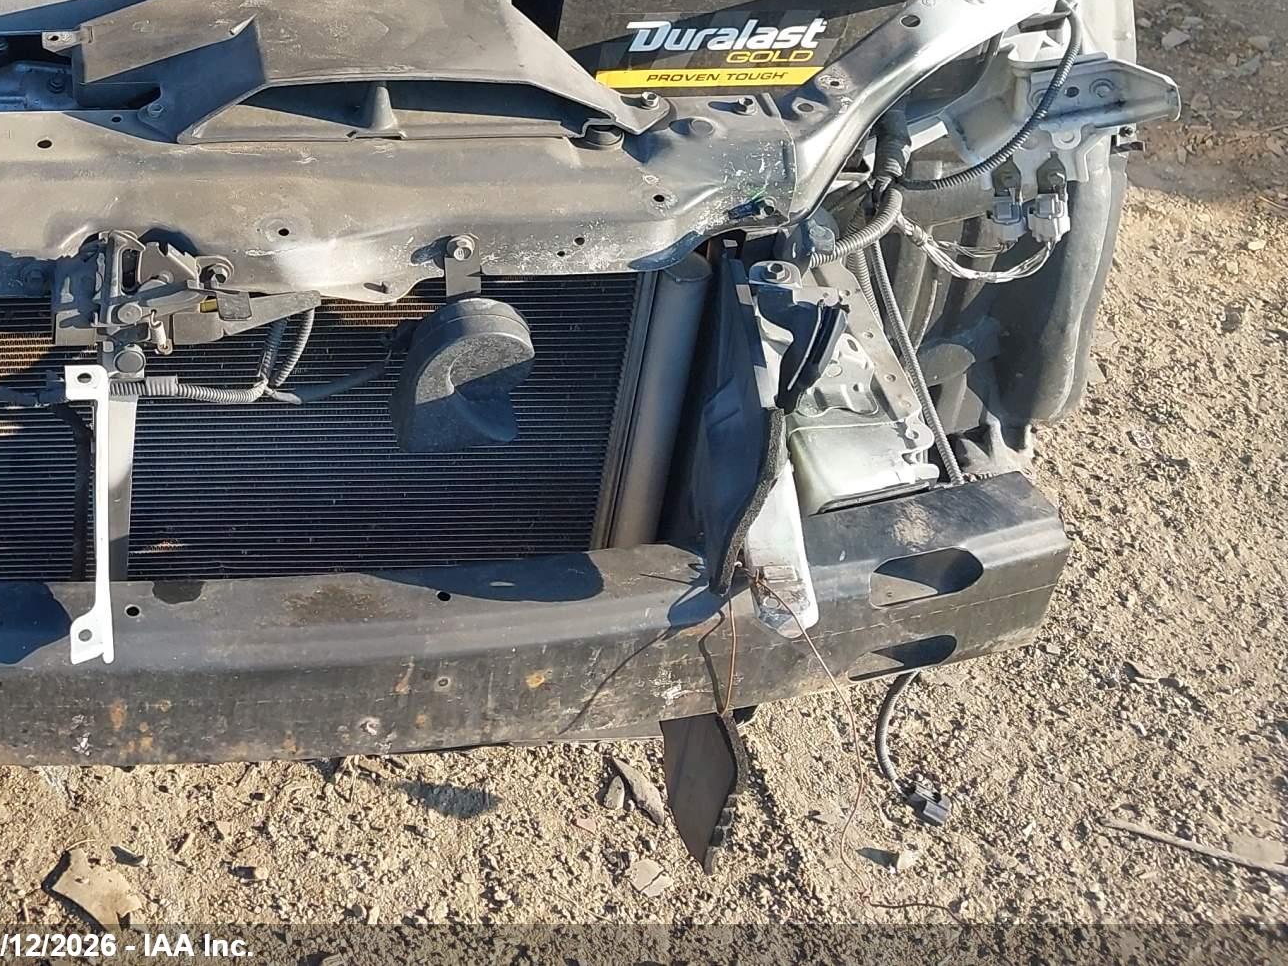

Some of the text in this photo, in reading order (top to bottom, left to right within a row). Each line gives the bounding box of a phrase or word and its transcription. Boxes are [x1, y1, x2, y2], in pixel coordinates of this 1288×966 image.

[626, 18, 827, 52] Duralast
[726, 50, 814, 64] GOLD
[646, 72, 786, 83] PROVEN TOUGH
